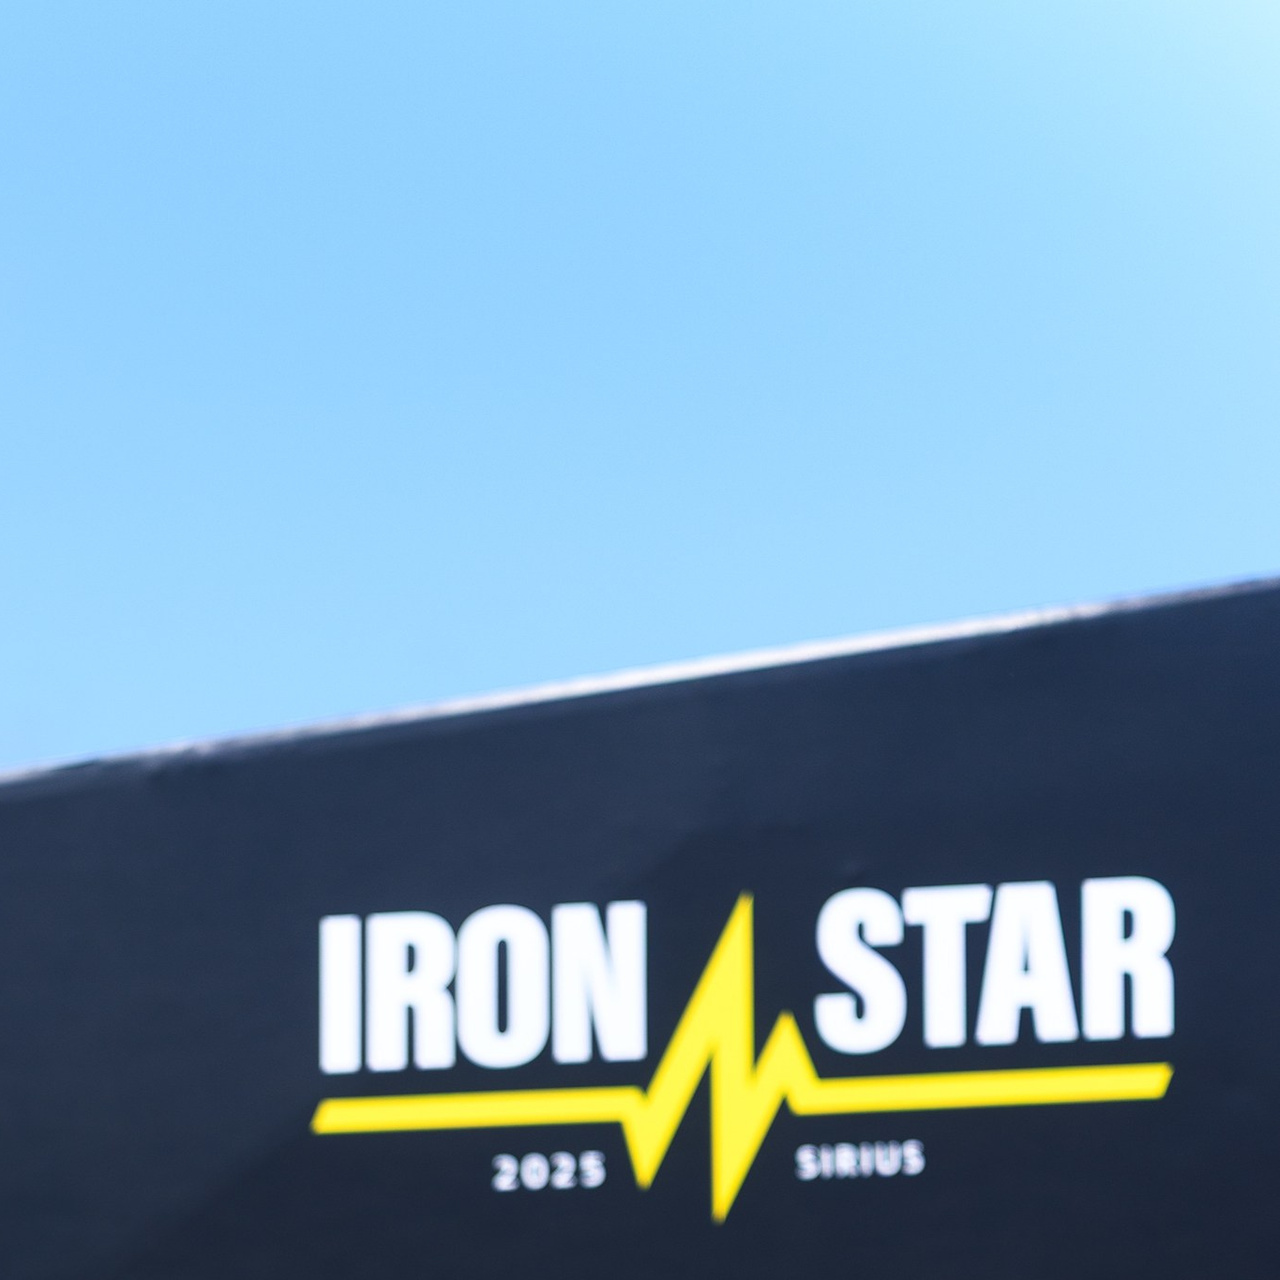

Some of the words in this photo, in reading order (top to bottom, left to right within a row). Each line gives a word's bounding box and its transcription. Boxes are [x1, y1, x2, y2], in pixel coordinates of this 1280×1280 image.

[319, 900, 647, 1075] IRON
[814, 876, 1175, 1054] STAR
[492, 1151, 606, 1192] 2025
[795, 1139, 925, 1180] SIRIUS
